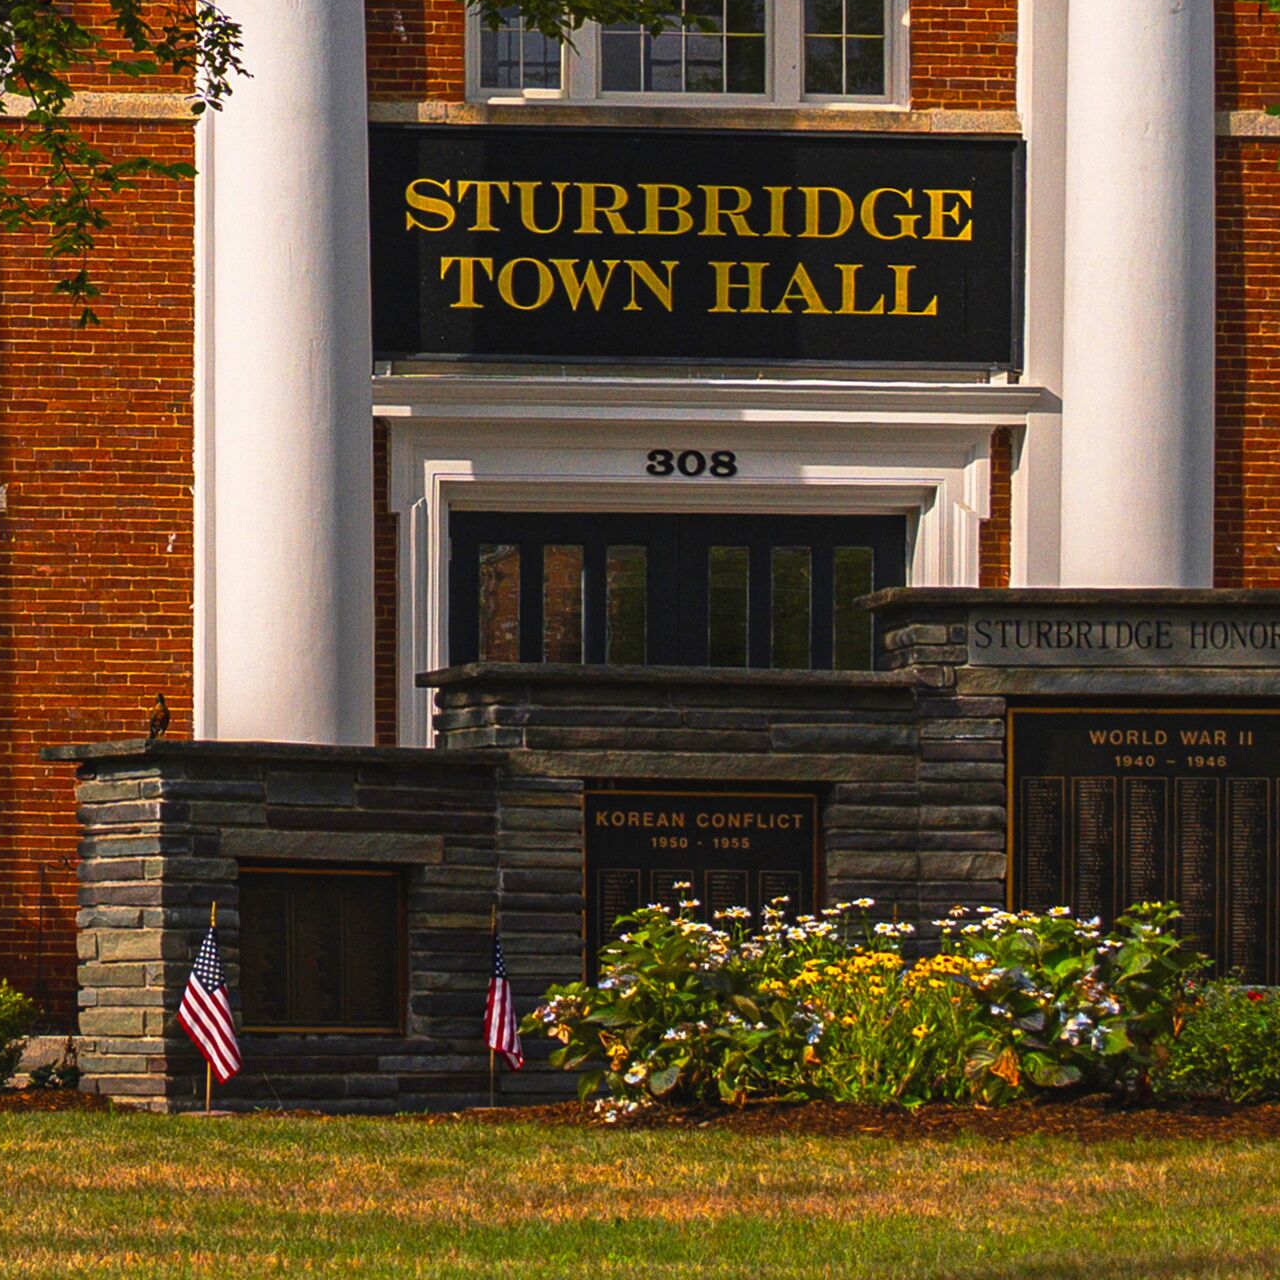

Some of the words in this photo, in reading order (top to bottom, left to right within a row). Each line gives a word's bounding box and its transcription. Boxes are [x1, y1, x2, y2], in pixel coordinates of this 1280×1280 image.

[404, 178, 974, 242] STURBRIDGE
[439, 255, 680, 312] TOWN
[707, 261, 939, 317] HALL
[645, 448, 739, 478] 308
[973, 619, 1174, 650] STURBRIDGE
[1088, 729, 1168, 746] WORLD
[1179, 729, 1227, 746] WAR
[1238, 729, 1253, 746] II
[1114, 754, 1156, 768] 1940
[1186, 755, 1228, 768] 1946
[595, 810, 686, 828] KOREAN
[695, 812, 804, 829] CONFLICT
[650, 836, 689, 849] 1950
[713, 836, 751, 849] 1955
